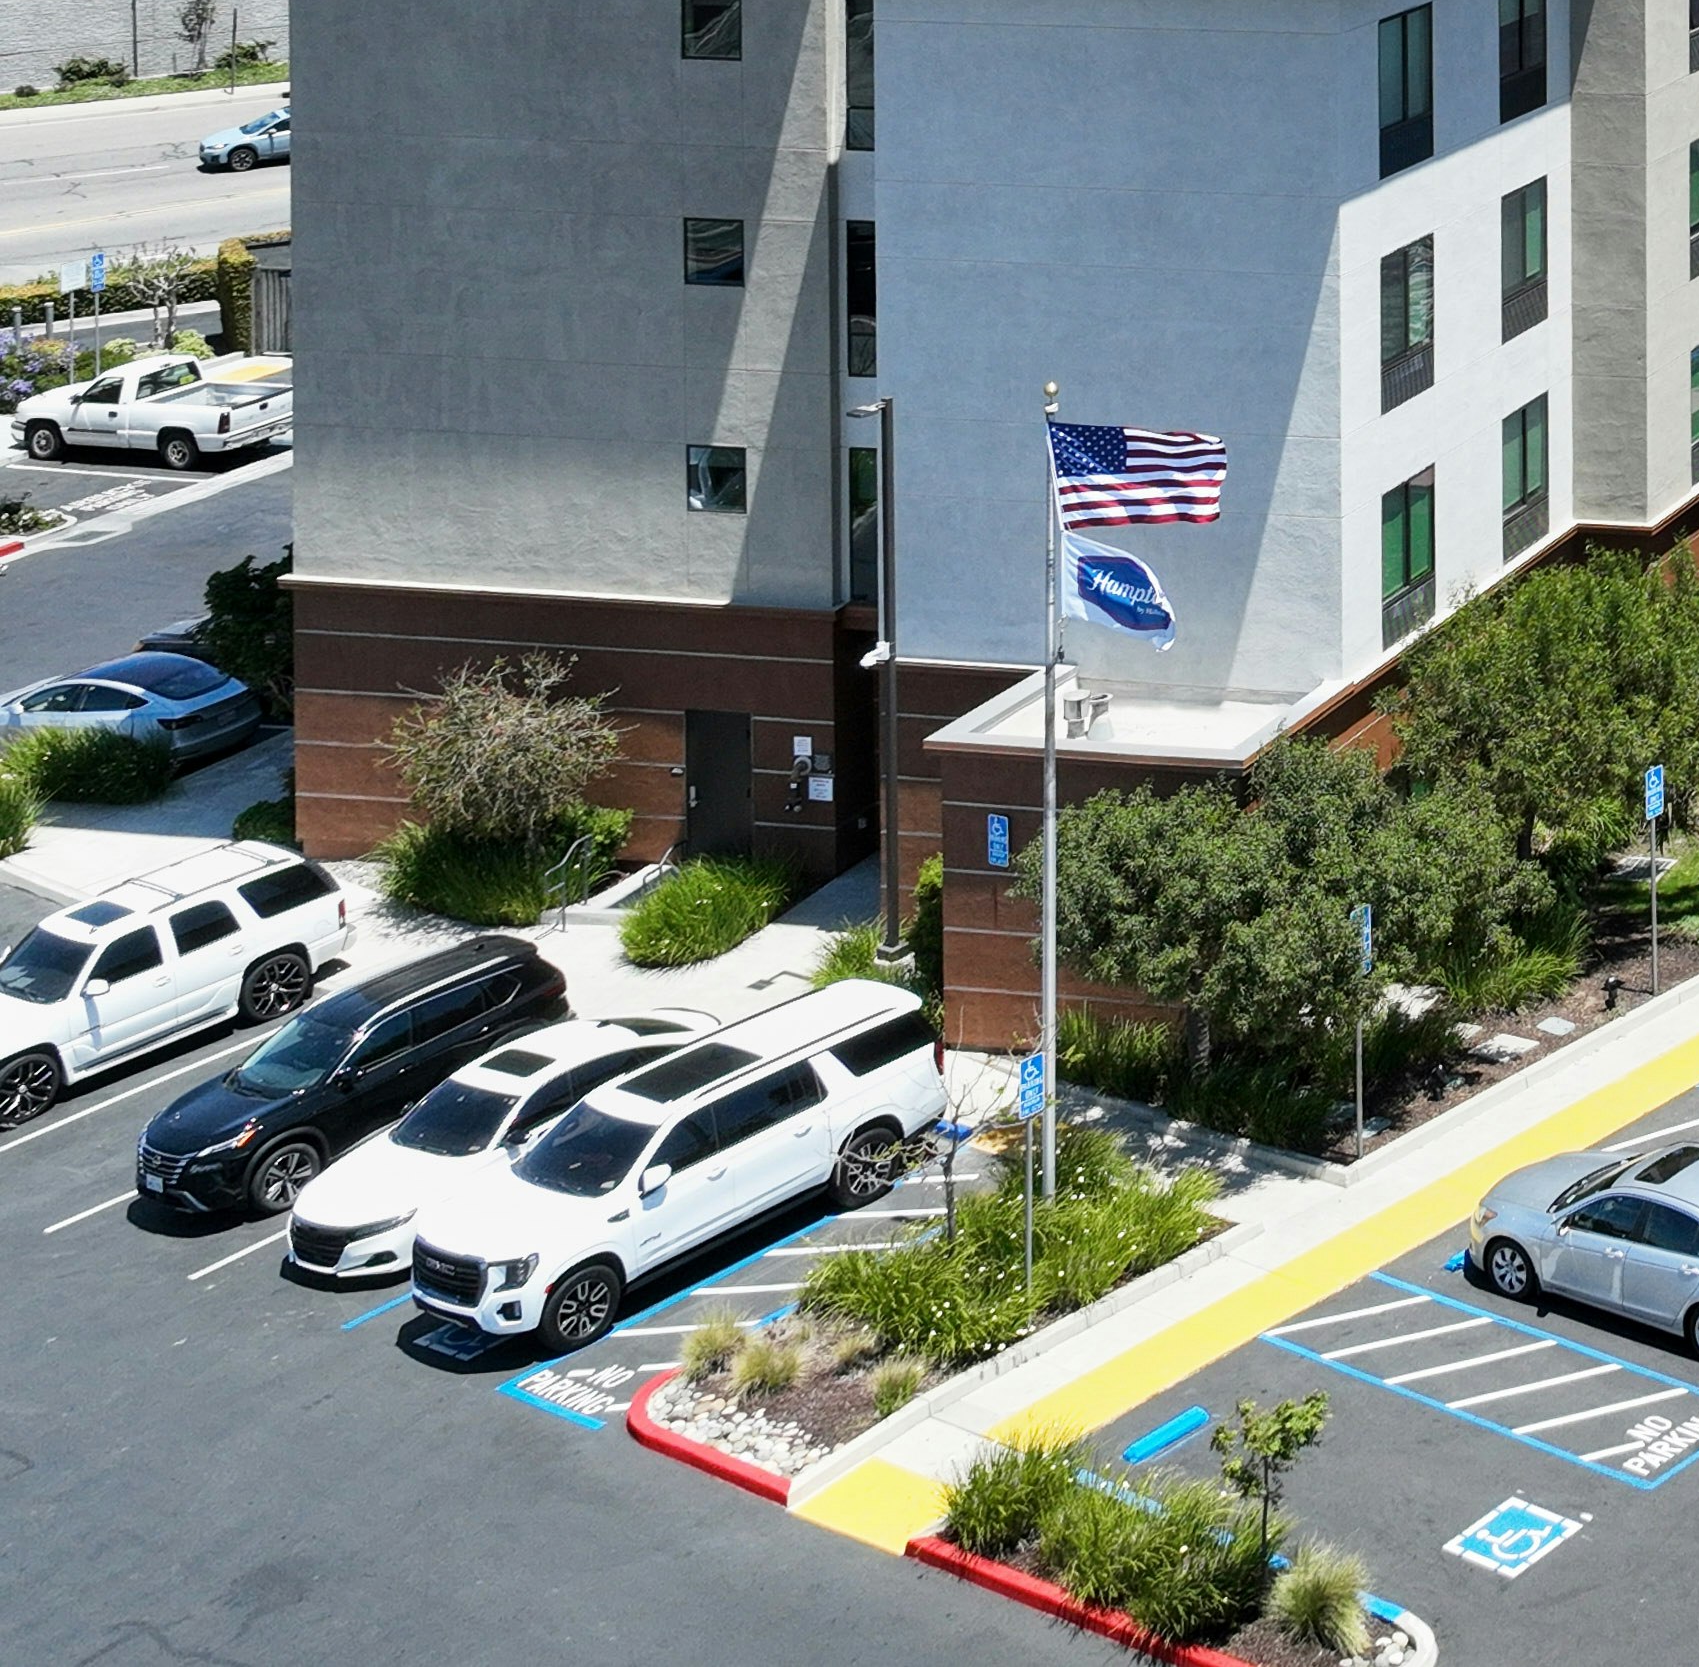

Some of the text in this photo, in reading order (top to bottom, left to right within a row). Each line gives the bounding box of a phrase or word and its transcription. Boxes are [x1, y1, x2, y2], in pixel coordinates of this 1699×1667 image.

[586, 1364, 636, 1389] NO
[516, 1368, 616, 1416] PARKING
[1626, 1415, 1673, 1444] NO
